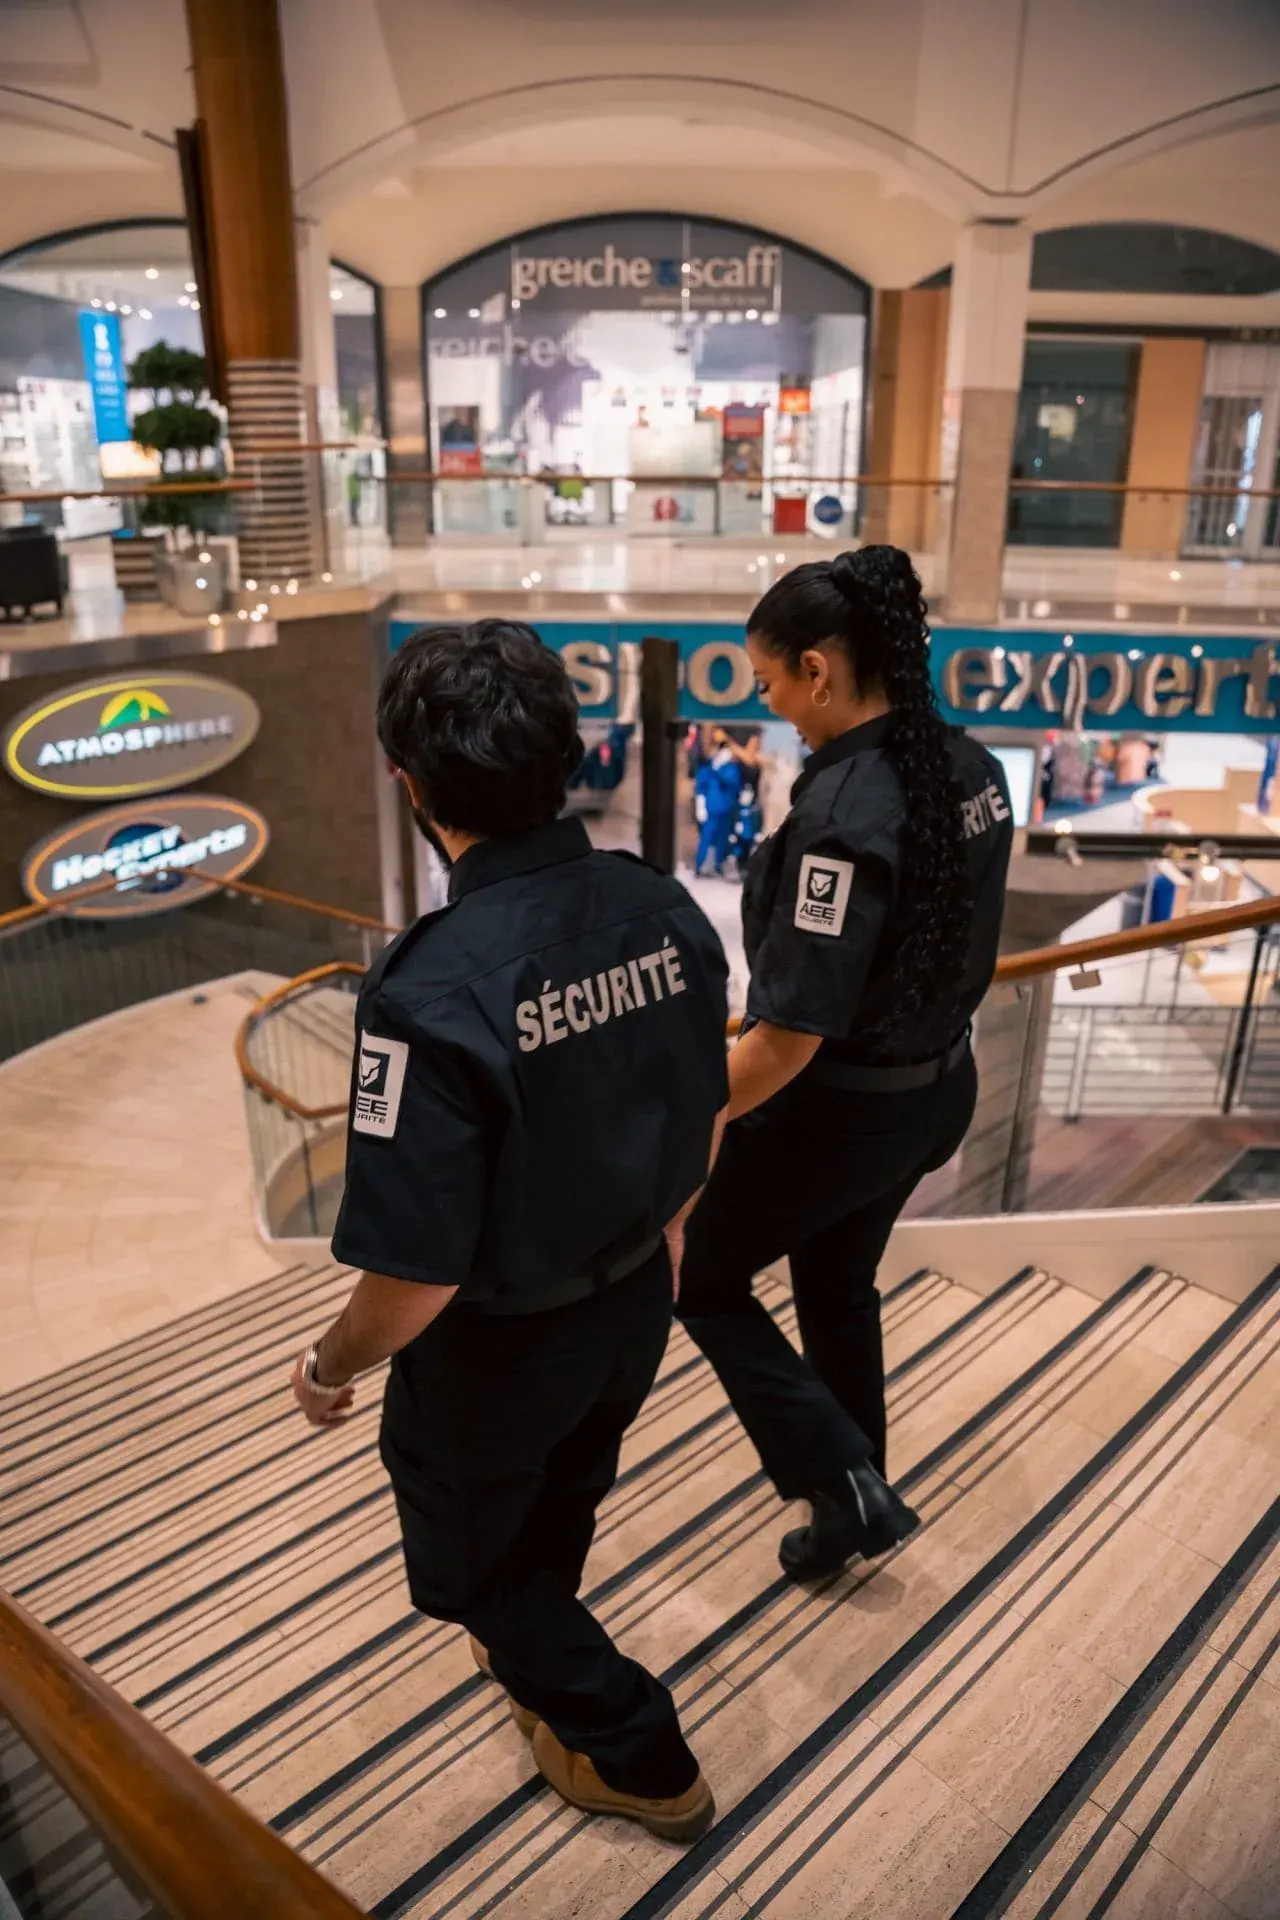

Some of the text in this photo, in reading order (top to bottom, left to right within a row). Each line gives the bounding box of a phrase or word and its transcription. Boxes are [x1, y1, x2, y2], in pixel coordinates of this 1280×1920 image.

[518, 245, 652, 299] greiche
[687, 246, 780, 288] scaff
[37, 715, 233, 767] ATMOSPHERE
[959, 777, 1010, 839] RITÉ
[800, 902, 836, 921] AEE
[515, 935, 687, 1053] SÉCURITÉ
